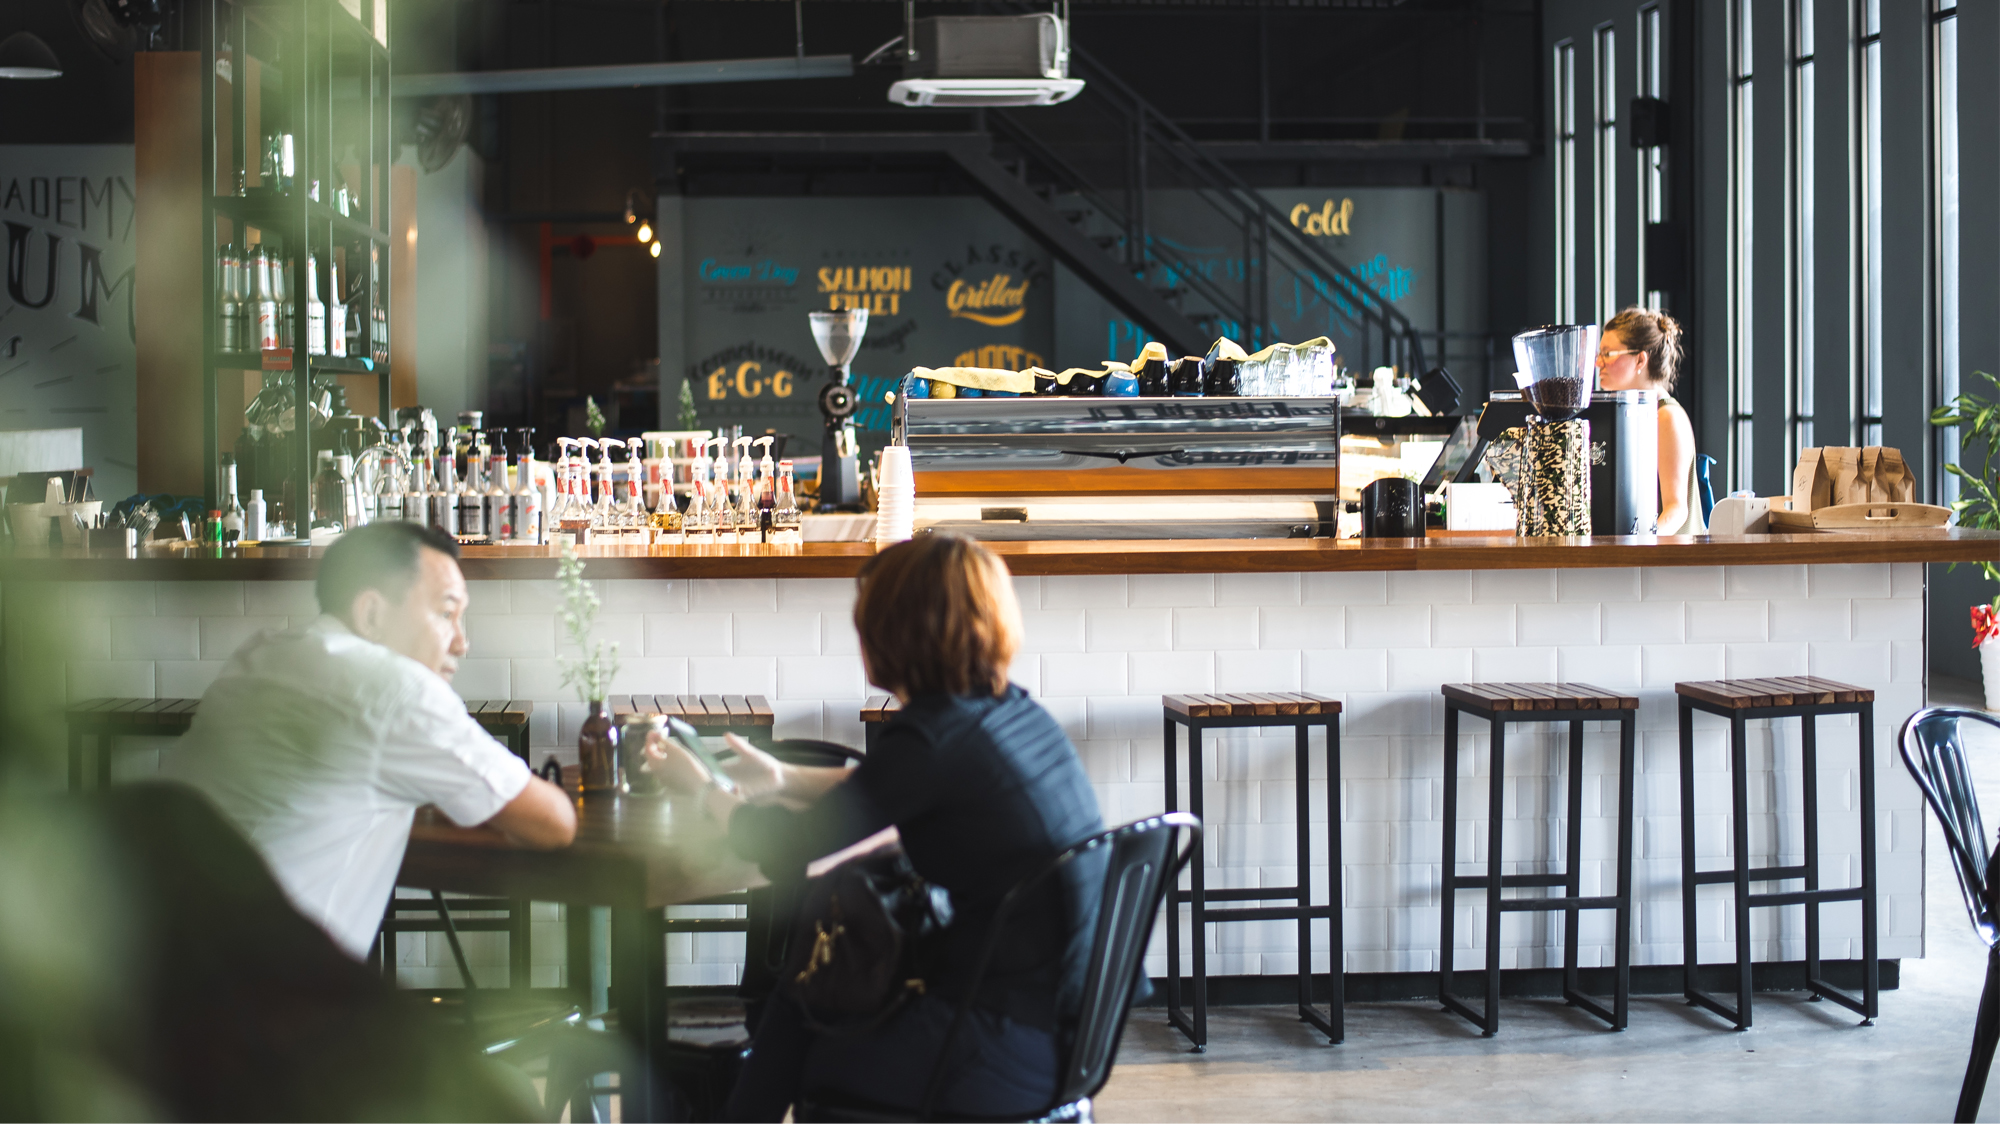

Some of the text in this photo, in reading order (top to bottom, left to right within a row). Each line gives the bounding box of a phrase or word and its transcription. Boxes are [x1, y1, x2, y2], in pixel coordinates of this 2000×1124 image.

[0, 176, 135, 244] ADEMY
[1290, 197, 1354, 236] Cold
[818, 267, 911, 291] SALMON
[931, 244, 1049, 291] CLASSIC
[830, 293, 900, 315] FILLET
[946, 274, 1030, 311] Grilled
